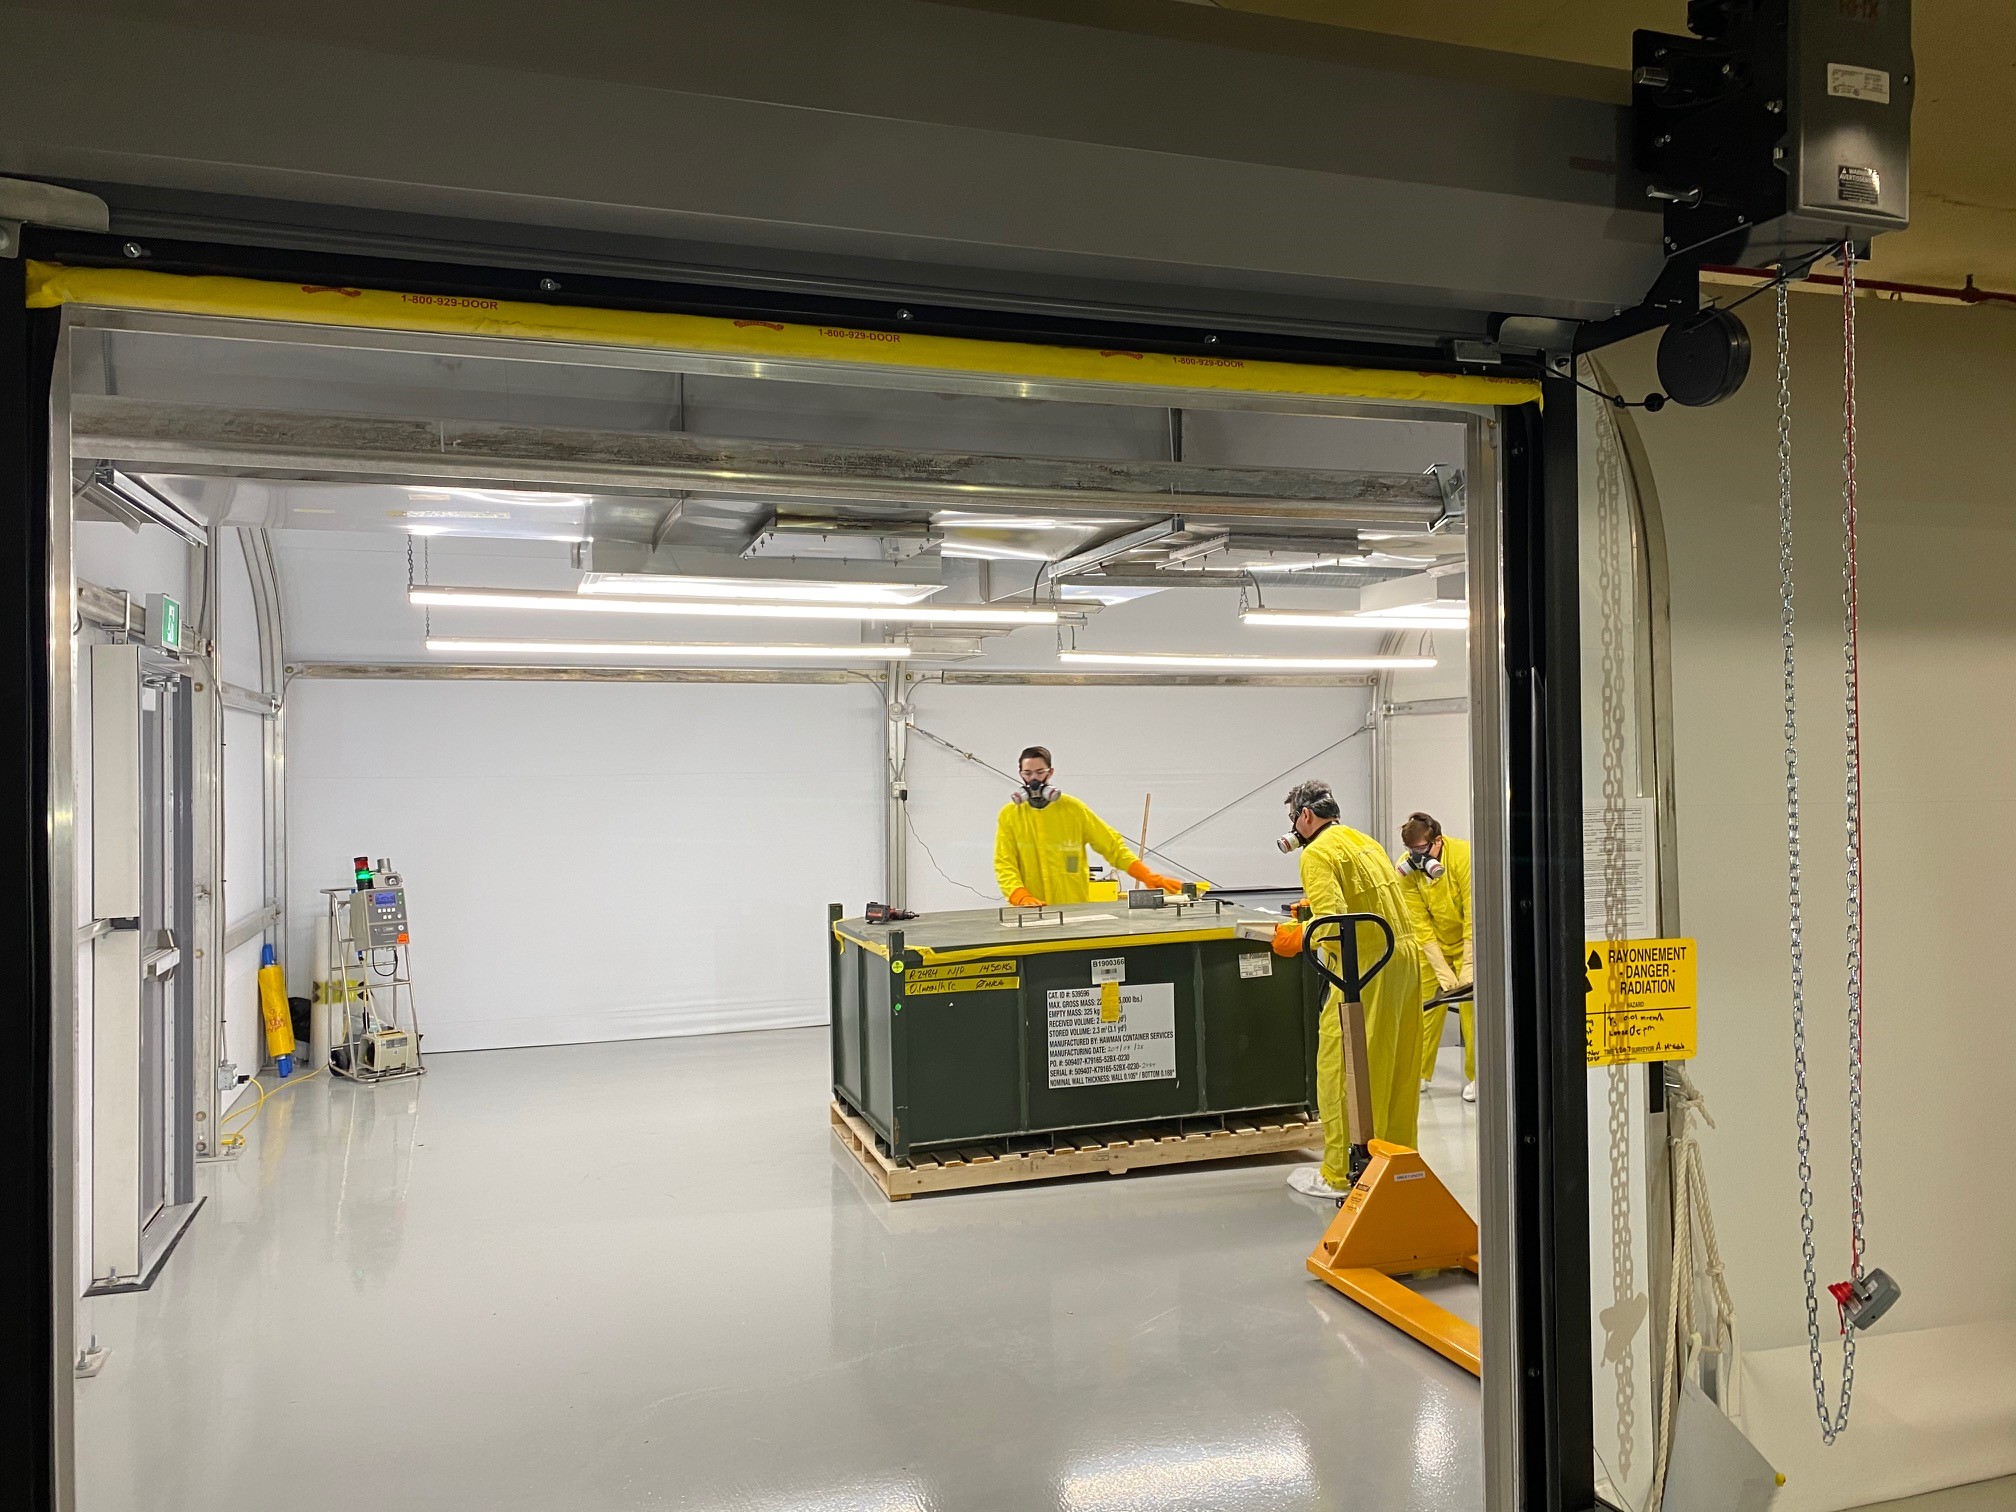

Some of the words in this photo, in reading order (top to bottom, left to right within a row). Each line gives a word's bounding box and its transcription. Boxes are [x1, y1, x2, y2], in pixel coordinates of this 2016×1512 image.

[401, 294, 498, 310] 1-800-929-DOOR
[818, 328, 901, 343] 1-800-929-DOOR
[1173, 356, 1245, 368] 1-800-929-DOOR
[1608, 946, 1687, 964] RAYONNEMENT
[1092, 958, 1125, 968] B1900366
[1626, 963, 1669, 979] DANGER
[1620, 979, 1676, 995] RADIATION
[1049, 1001, 1061, 1009] MAX.
[1062, 1000, 1080, 1008] GROSS
[1080, 999, 1096, 1007] MASS:
[1049, 1010, 1066, 1018] EMPTY
[1067, 1009, 1082, 1017] MASS:
[1084, 1008, 1093, 1016] 325
[1049, 1019, 1074, 1028] RECEIVED
[1074, 1018, 1096, 1026] VOLUME:
[1049, 1029, 1069, 1038] STORED
[1070, 1028, 1091, 1036] VOLUME:
[1050, 1038, 1090, 1048] MANUFACTURED
[1099, 1035, 1122, 1044] HAWMAN
[1122, 1033, 1149, 1042] CONTAINER
[1150, 1031, 1174, 1040] SERVICES
[1050, 1047, 1092, 1057] MANUFACTURING
[1093, 1046, 1106, 1055] DATE:
[1050, 1069, 1068, 1077] SERIAL
[1050, 1078, 1071, 1087] NOMINAL
[1071, 1077, 1085, 1085] WALL
[1111, 1073, 1124, 1081] WALL
[1142, 1070, 1160, 1078] BOTTOM
